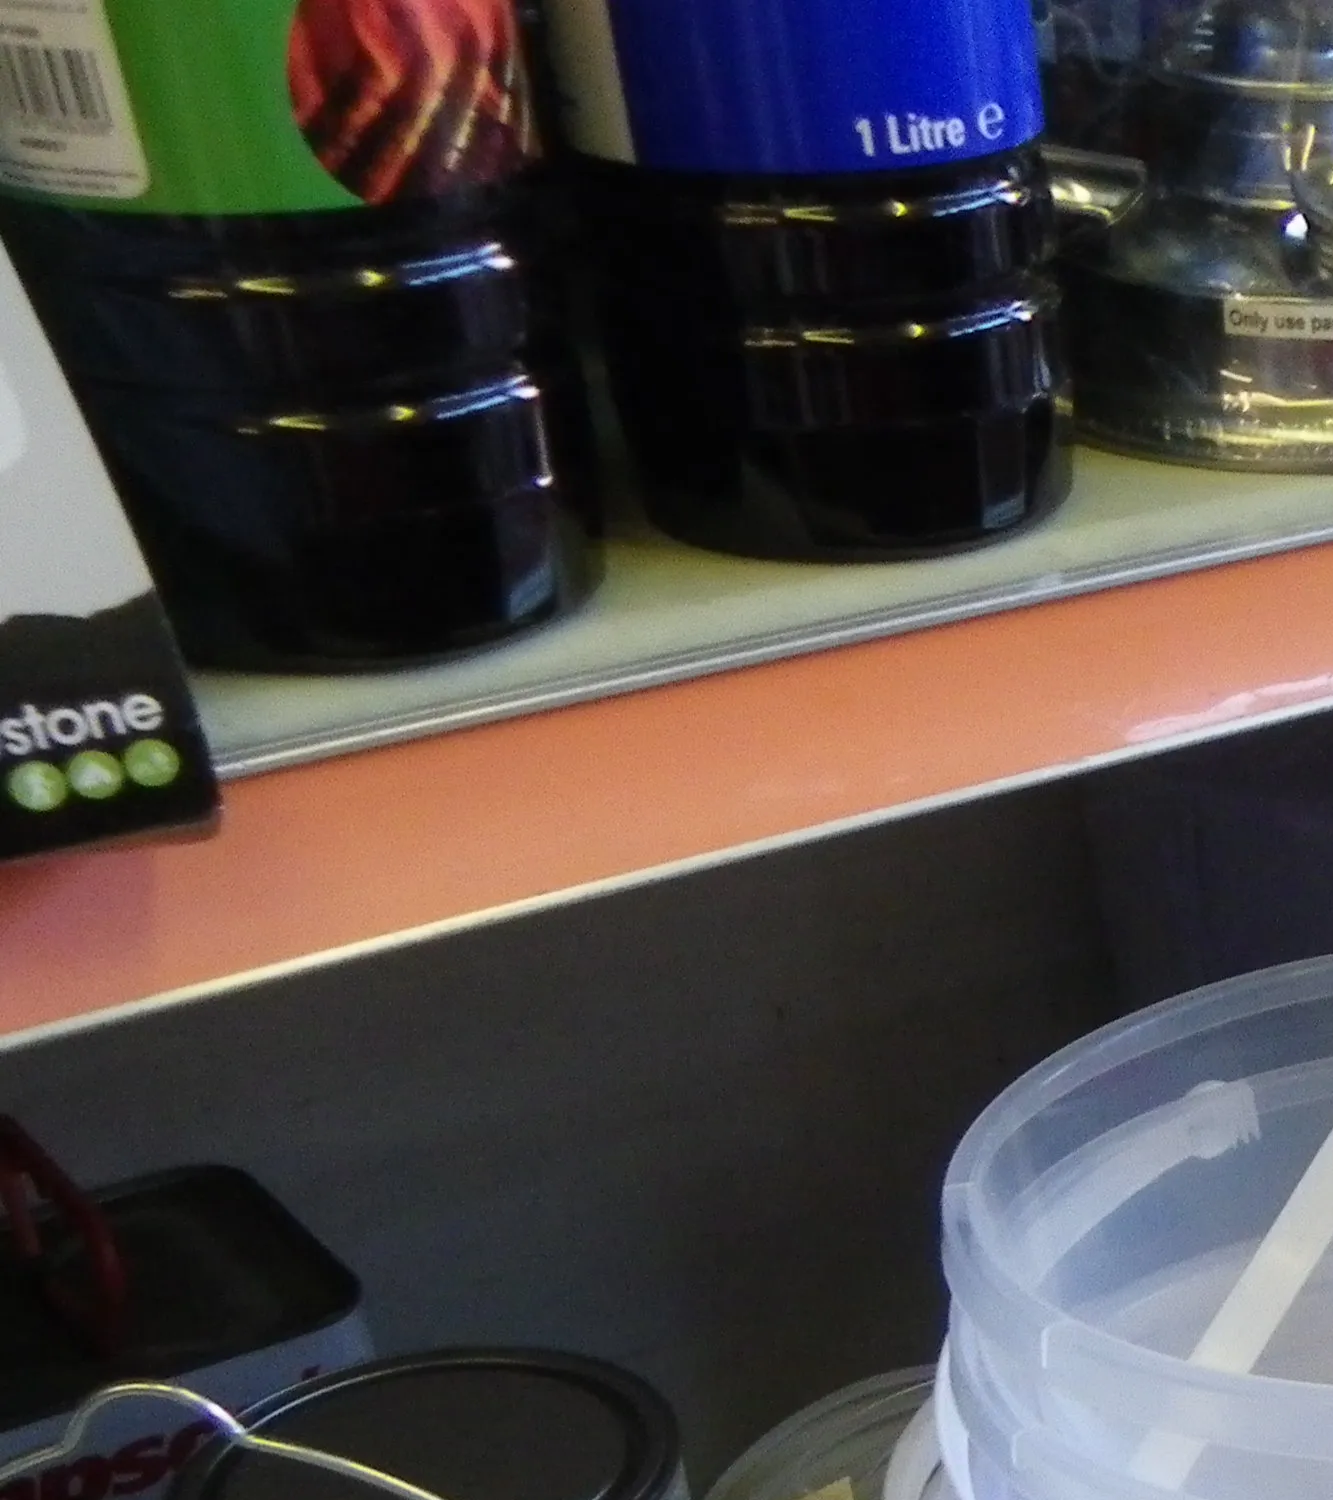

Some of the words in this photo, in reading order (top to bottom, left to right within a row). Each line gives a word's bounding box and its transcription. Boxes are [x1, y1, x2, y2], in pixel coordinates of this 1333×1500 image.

[855, 117, 875, 157] 1
[885, 112, 966, 154] Litre
[1274, 314, 1305, 330] use
